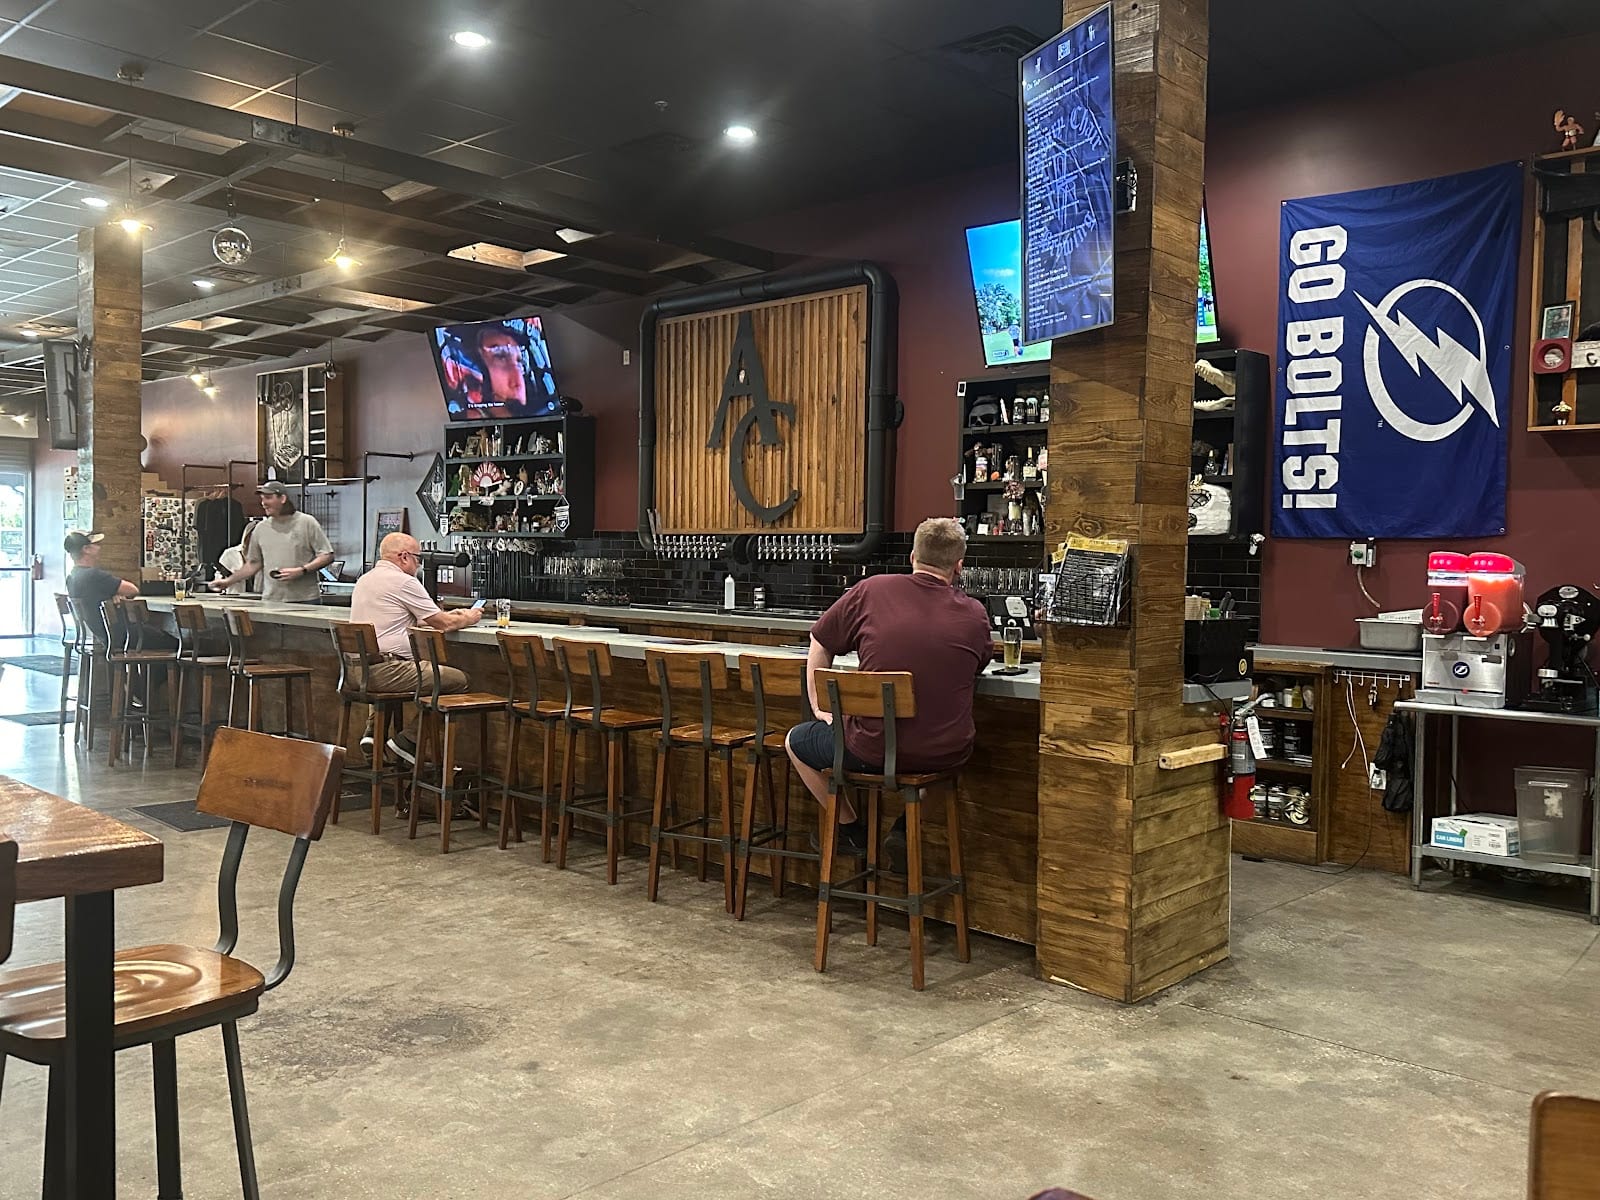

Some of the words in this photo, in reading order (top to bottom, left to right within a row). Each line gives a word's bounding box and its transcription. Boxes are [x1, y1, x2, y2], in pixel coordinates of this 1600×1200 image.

[1070, 105, 1102, 151] Chair
[1289, 224, 1348, 304] GO
[1282, 316, 1344, 508] BOLTS!
[1435, 834, 1446, 842] CAN
[1446, 836, 1463, 844] LINERS
